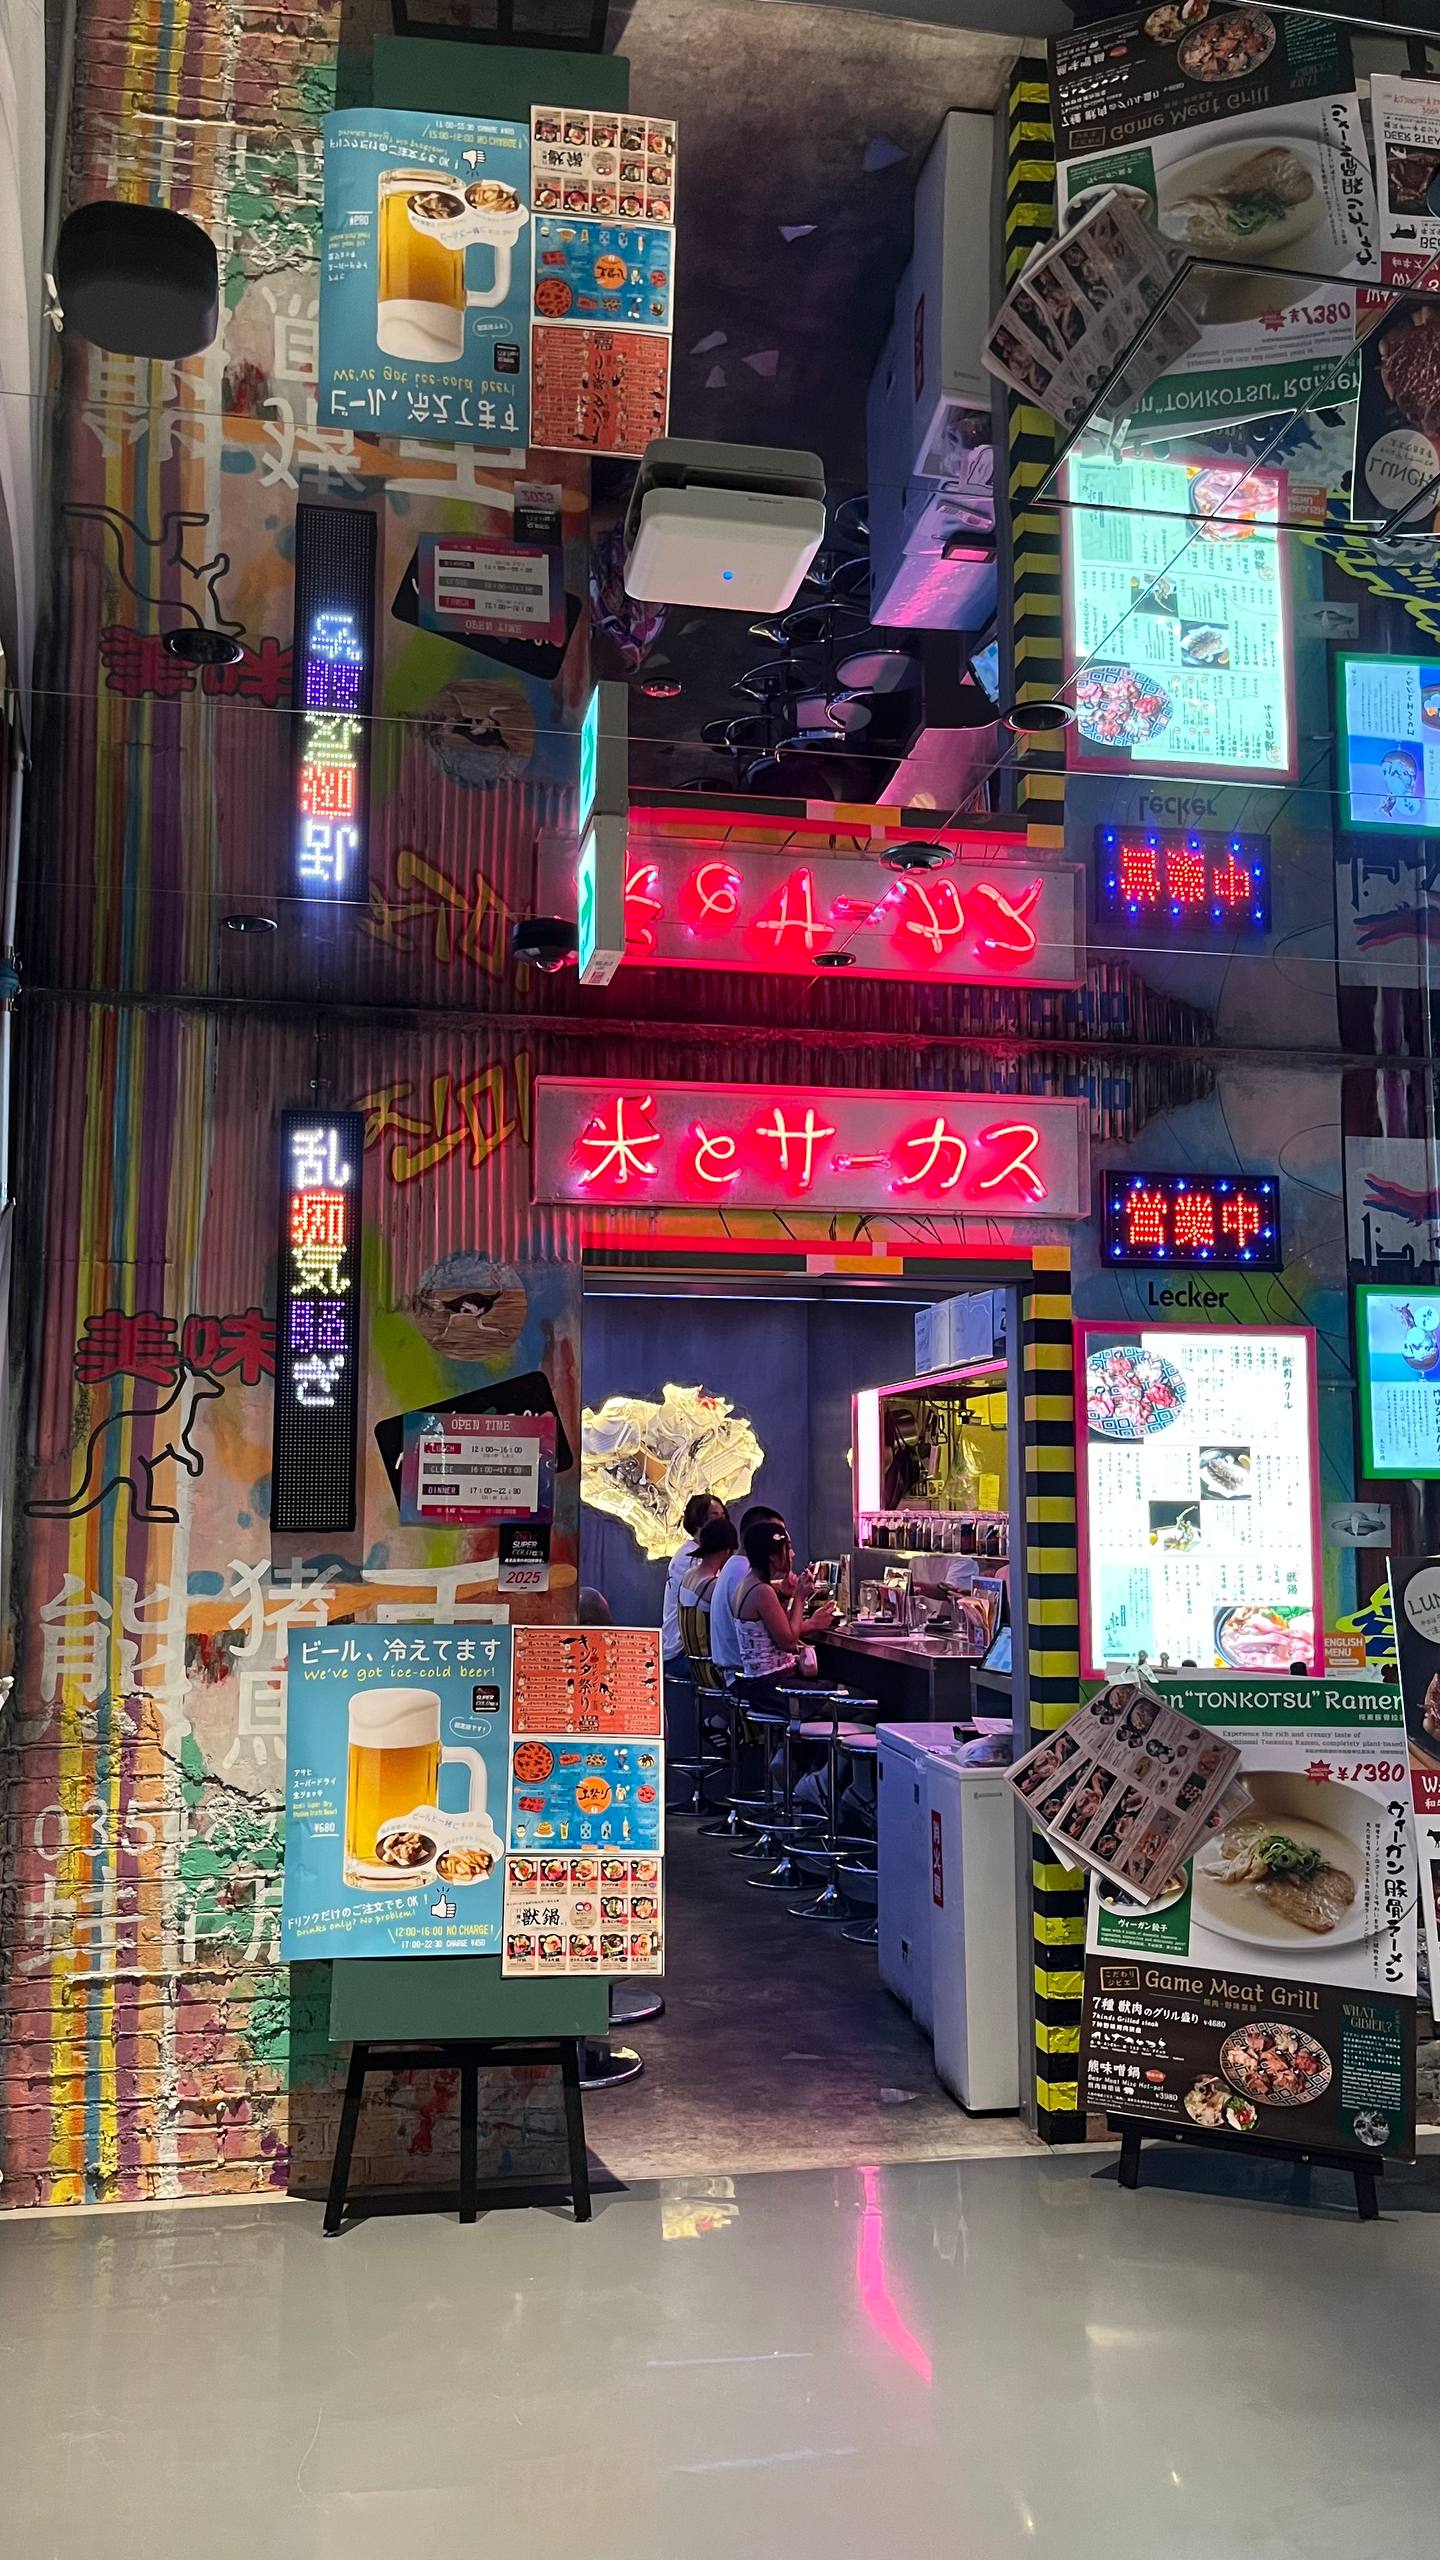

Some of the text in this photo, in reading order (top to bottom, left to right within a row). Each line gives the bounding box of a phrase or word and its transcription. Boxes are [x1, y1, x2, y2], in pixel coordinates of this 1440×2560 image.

[575, 1096, 1048, 1202] 米とサーカス
[1125, 1191, 1260, 1248] 営業中
[291, 1128, 351, 1408] 乱痴気騒ぎ
[1148, 1281, 1229, 1308] Lecker
[75, 1307, 277, 1387] 美味
[451, 1418, 511, 1432] OPEN TIME
[427, 1486, 457, 1495] DINNER
[512, 1541, 538, 1549] SUPER
[506, 1571, 542, 1584] 2025
[1324, 1638, 1363, 1647] ENGLISH
[301, 1638, 501, 1665] ビール、冷えてます
[1325, 1647, 1352, 1657] MENU
[304, 1664, 496, 1682] We've got ice-cold beer!
[294, 1768, 313, 1777] アサヒ
[1336, 1759, 1405, 1783] ¥1380
[294, 1776, 337, 1788] スーパードライ
[314, 1822, 336, 1833] ¥680
[1384, 1800, 1409, 1983] ヴィーガン豚骨ラーメン
[287, 1898, 405, 1931] ドリンクだけのご注文でも
[521, 1907, 560, 1926] 獣鍋
[296, 1908, 416, 1938] Drinks only? No problem!
[1118, 1918, 1168, 1933] ヴィーガン餃子
[394, 1925, 443, 1938] 12:00-16:00
[446, 1926, 459, 1937] NO
[446, 1938, 468, 1948] CHARGE
[1104, 1970, 1136, 1979] こだわり
[1107, 1979, 1132, 1987] ジビエ
[1145, 1970, 1204, 1994] Game
[1209, 1978, 1264, 2002] Meat
[1271, 1986, 1320, 2011] Grill
[1342, 2003, 1376, 2019] WHAT
[1117, 2015, 1140, 2026] Grilled
[1203, 2019, 1227, 2029] ¥4680
[1350, 2018, 1393, 2033] GIBIER?
[1087, 2058, 1141, 2080] 熊味噌鍋
[1104, 2076, 1120, 2085] Meat
[1122, 2078, 1137, 2088] Miso
[1138, 2081, 1164, 2092] Hot-pot
[1155, 2092, 1178, 2102] ¥3980
